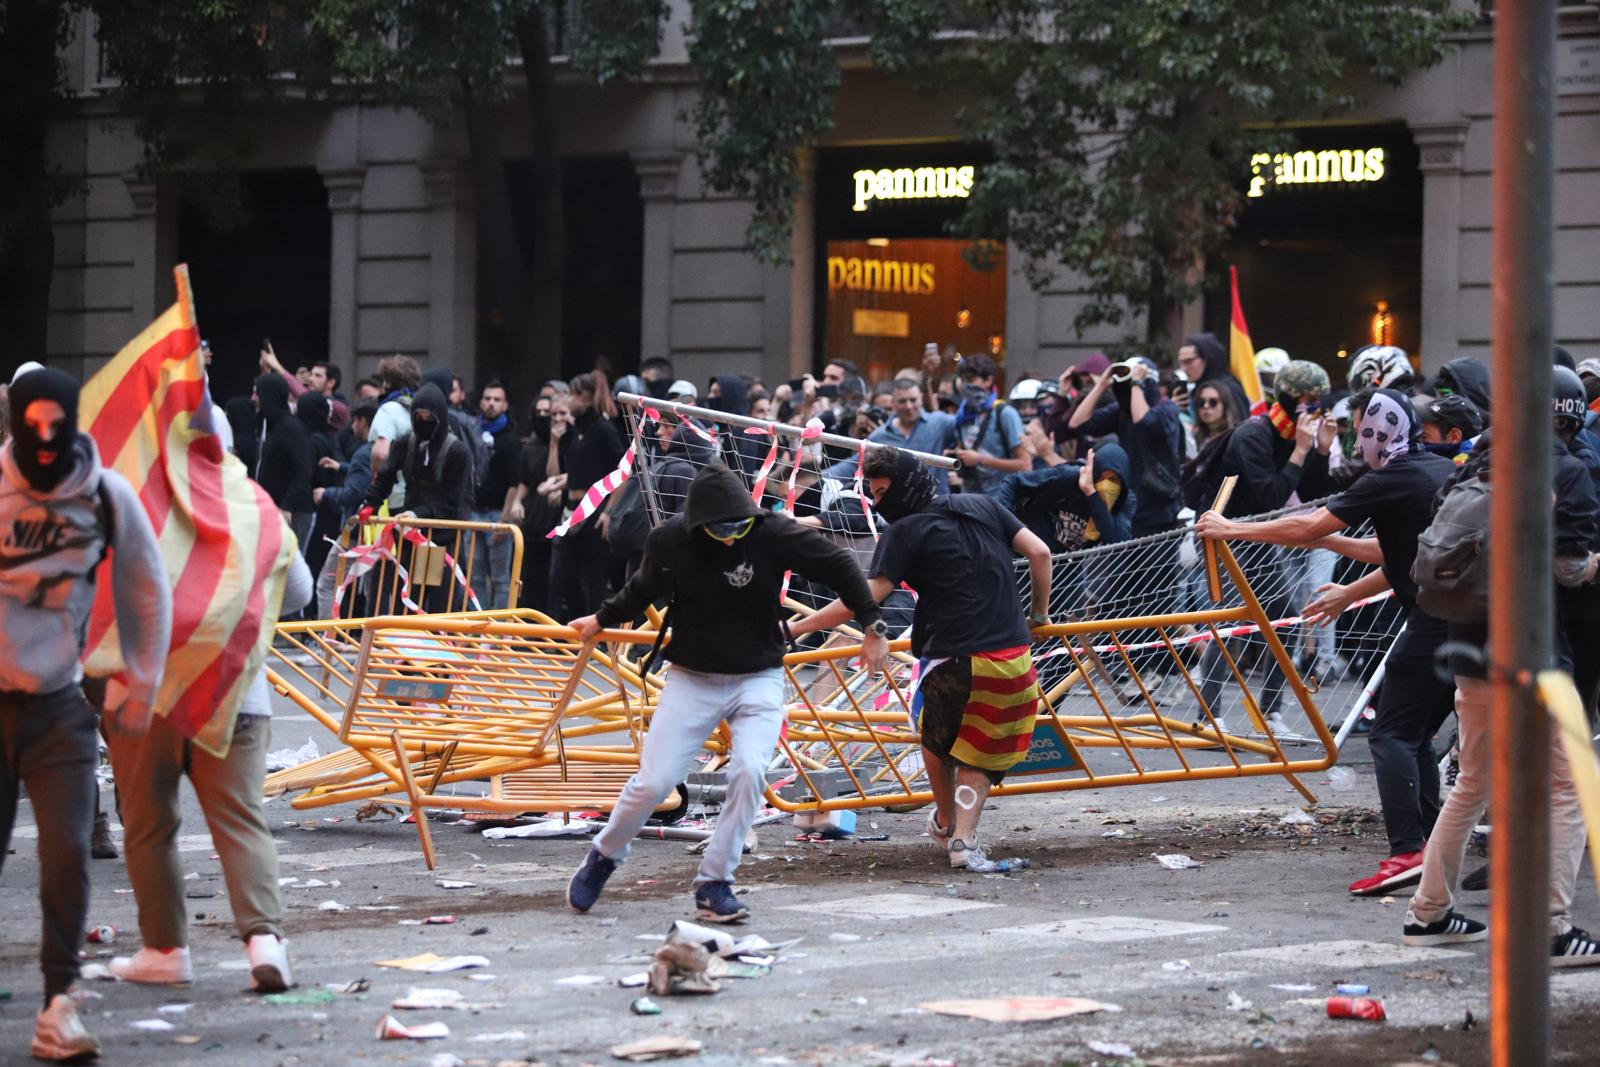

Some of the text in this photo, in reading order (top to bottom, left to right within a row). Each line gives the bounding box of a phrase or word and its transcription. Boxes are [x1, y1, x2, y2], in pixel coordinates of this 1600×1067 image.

[852, 165, 975, 212] pannus
[827, 256, 936, 297] pannus
[4, 518, 69, 553] NIKE
